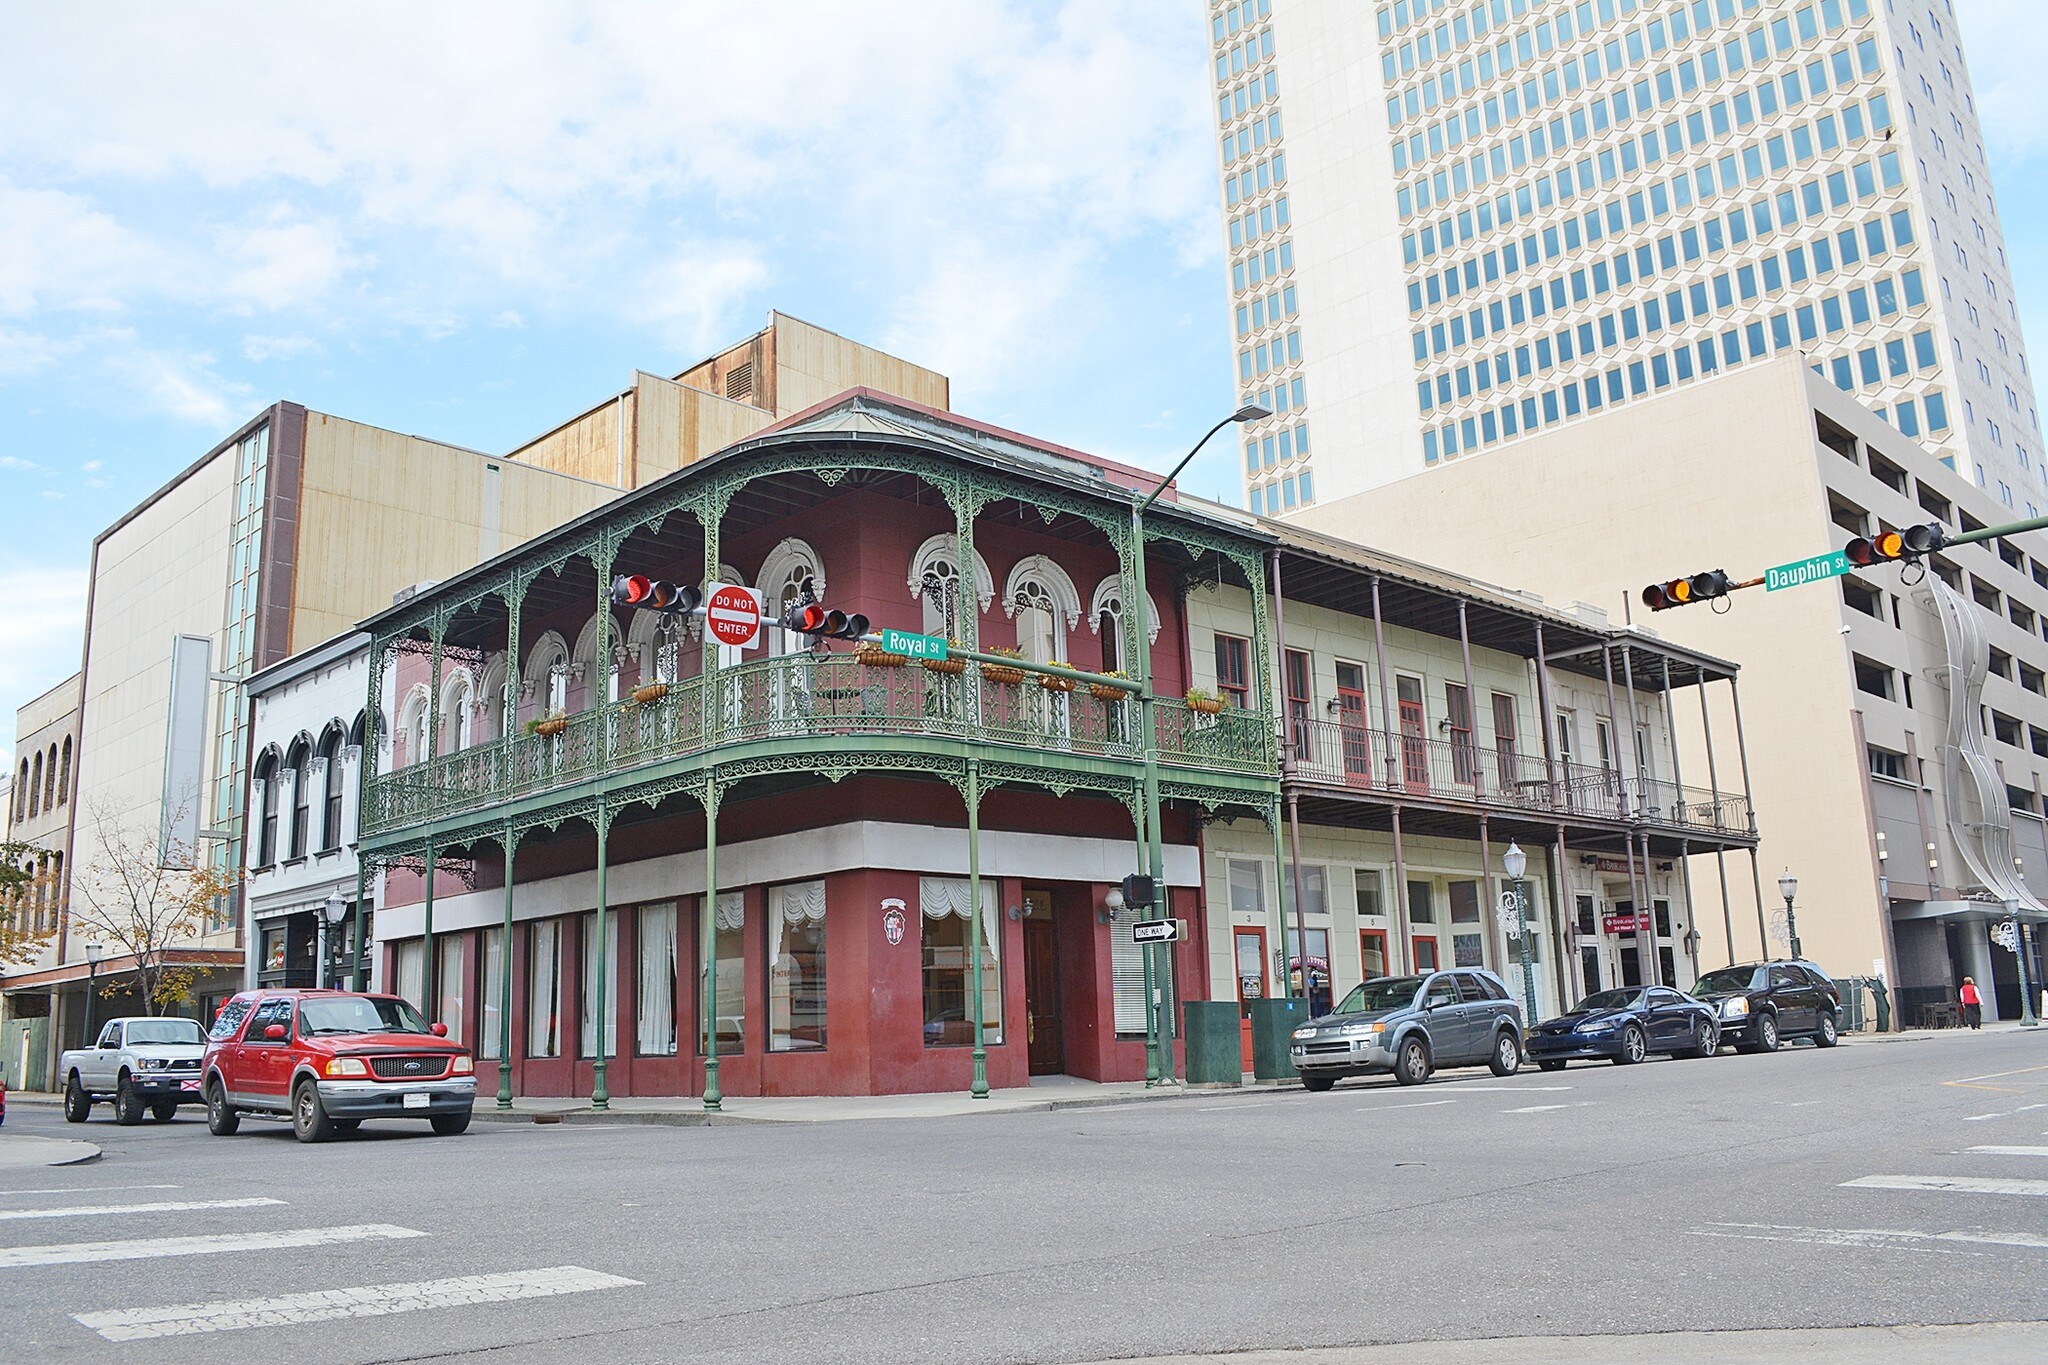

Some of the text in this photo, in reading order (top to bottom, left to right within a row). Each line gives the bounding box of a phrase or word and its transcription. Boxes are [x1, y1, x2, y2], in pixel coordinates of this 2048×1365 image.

[1769, 557, 1845, 589] Dauphin St
[716, 595, 754, 610] DO NOT
[717, 622, 748, 636] ENTER
[890, 632, 940, 656] Royal St
[1136, 927, 1164, 937] ONE WAY
